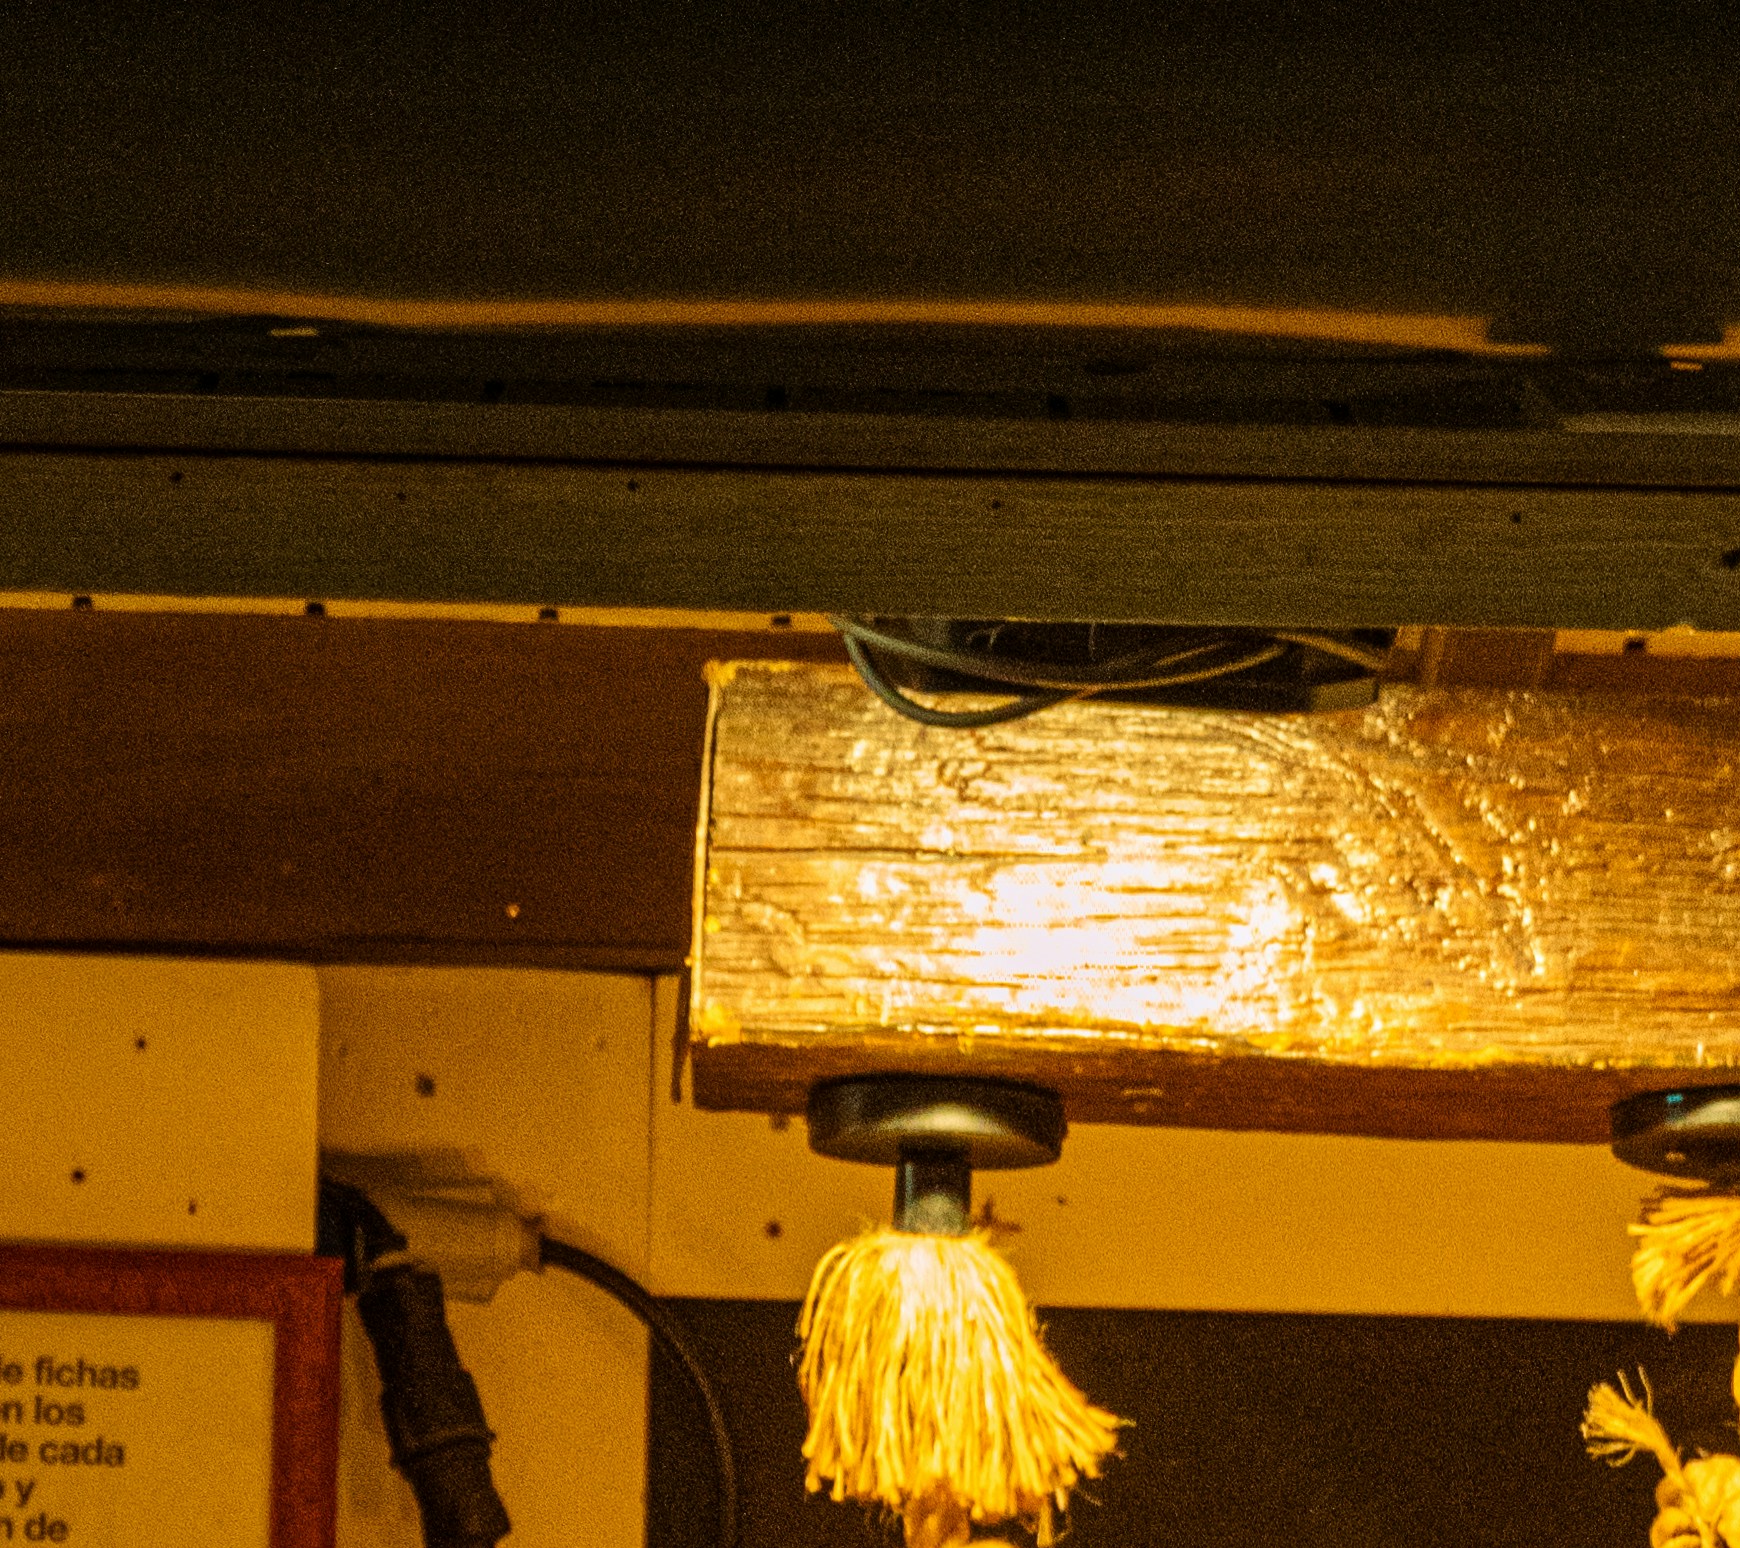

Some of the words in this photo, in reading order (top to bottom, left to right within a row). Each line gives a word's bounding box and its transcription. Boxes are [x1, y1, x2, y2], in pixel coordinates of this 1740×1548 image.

[34, 1355, 140, 1390] fichas
[34, 1395, 85, 1426] los
[38, 1435, 126, 1468] cada
[24, 1512, 69, 1542] de
